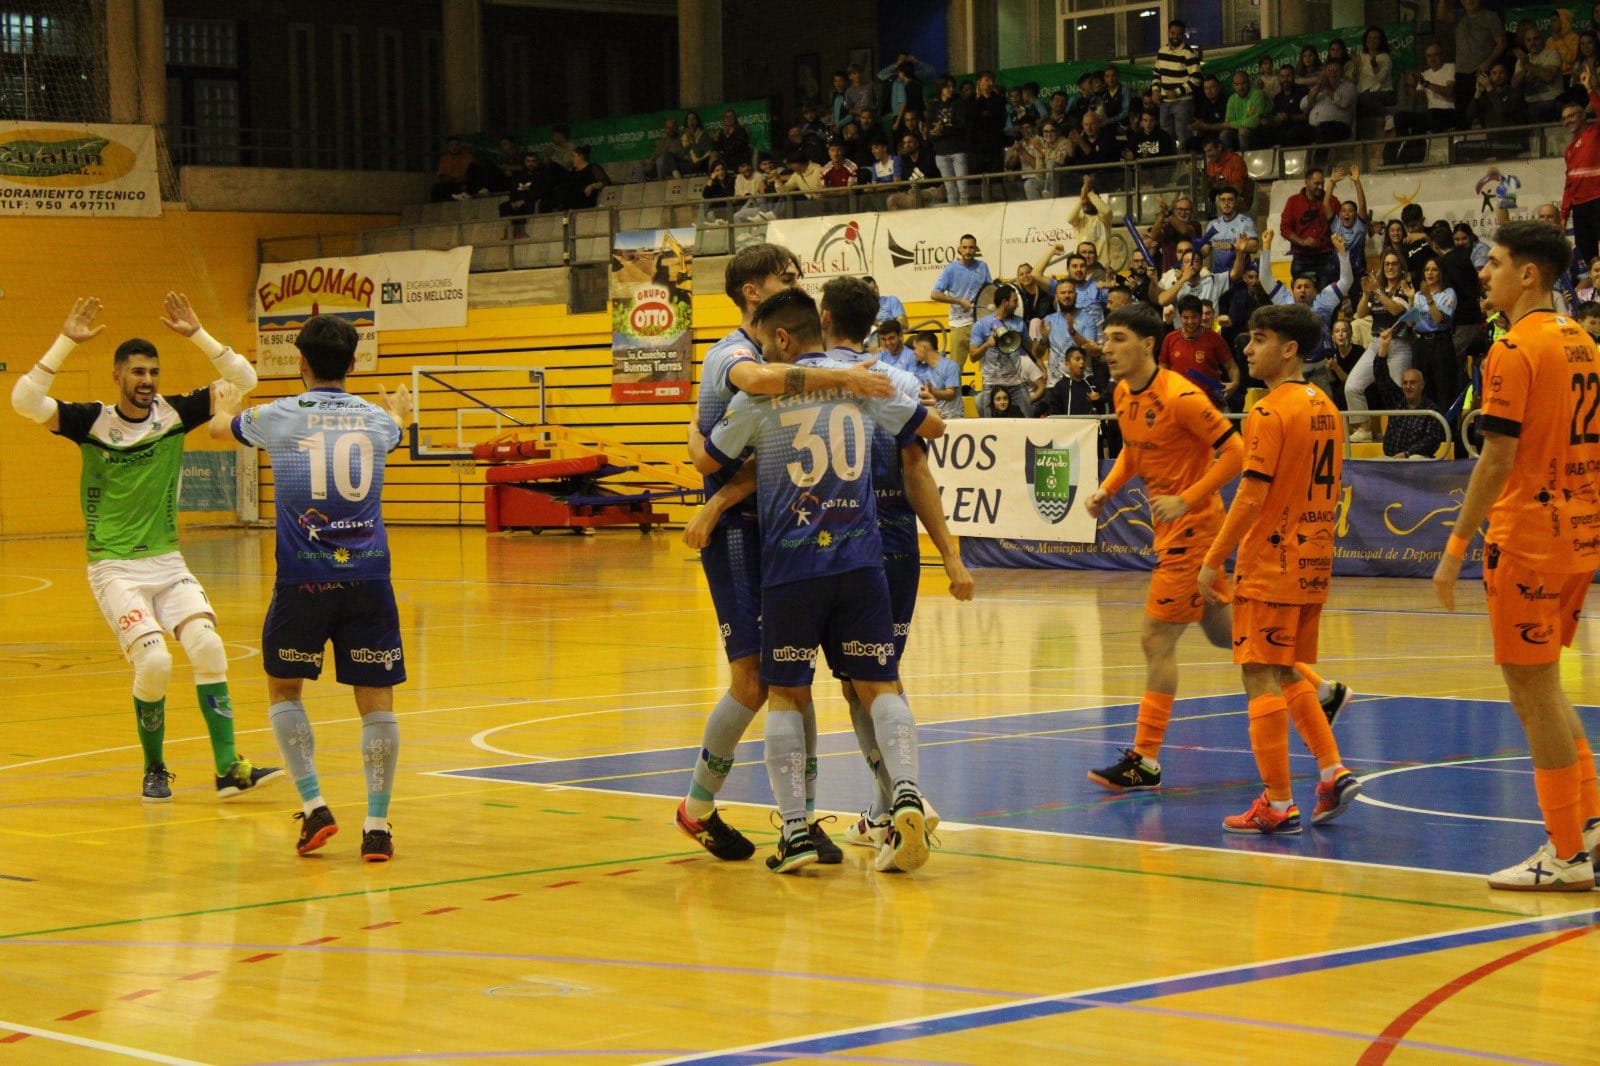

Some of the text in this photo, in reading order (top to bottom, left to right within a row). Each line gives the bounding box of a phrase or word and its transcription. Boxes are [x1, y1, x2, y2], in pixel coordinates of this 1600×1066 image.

[89, 190, 146, 201] TECNICO
[36, 201, 62, 210] 950
[69, 202, 116, 211] 497711
[258, 267, 375, 313] EJIDOMAR
[407, 288, 464, 304] LOS MELLIZOS
[637, 288, 667, 301] GRUPO
[634, 308, 669, 329] OTTO
[623, 360, 683, 374] Buenas Tierras
[1570, 372, 1600, 446] 22
[779, 402, 867, 488] 30
[298, 431, 375, 502] 10
[1307, 438, 1335, 502] 14
[1037, 542, 1085, 556] Municipal
[1086, 543, 1098, 553] de
[1332, 547, 1383, 561] Municipal
[1385, 548, 1399, 560] de
